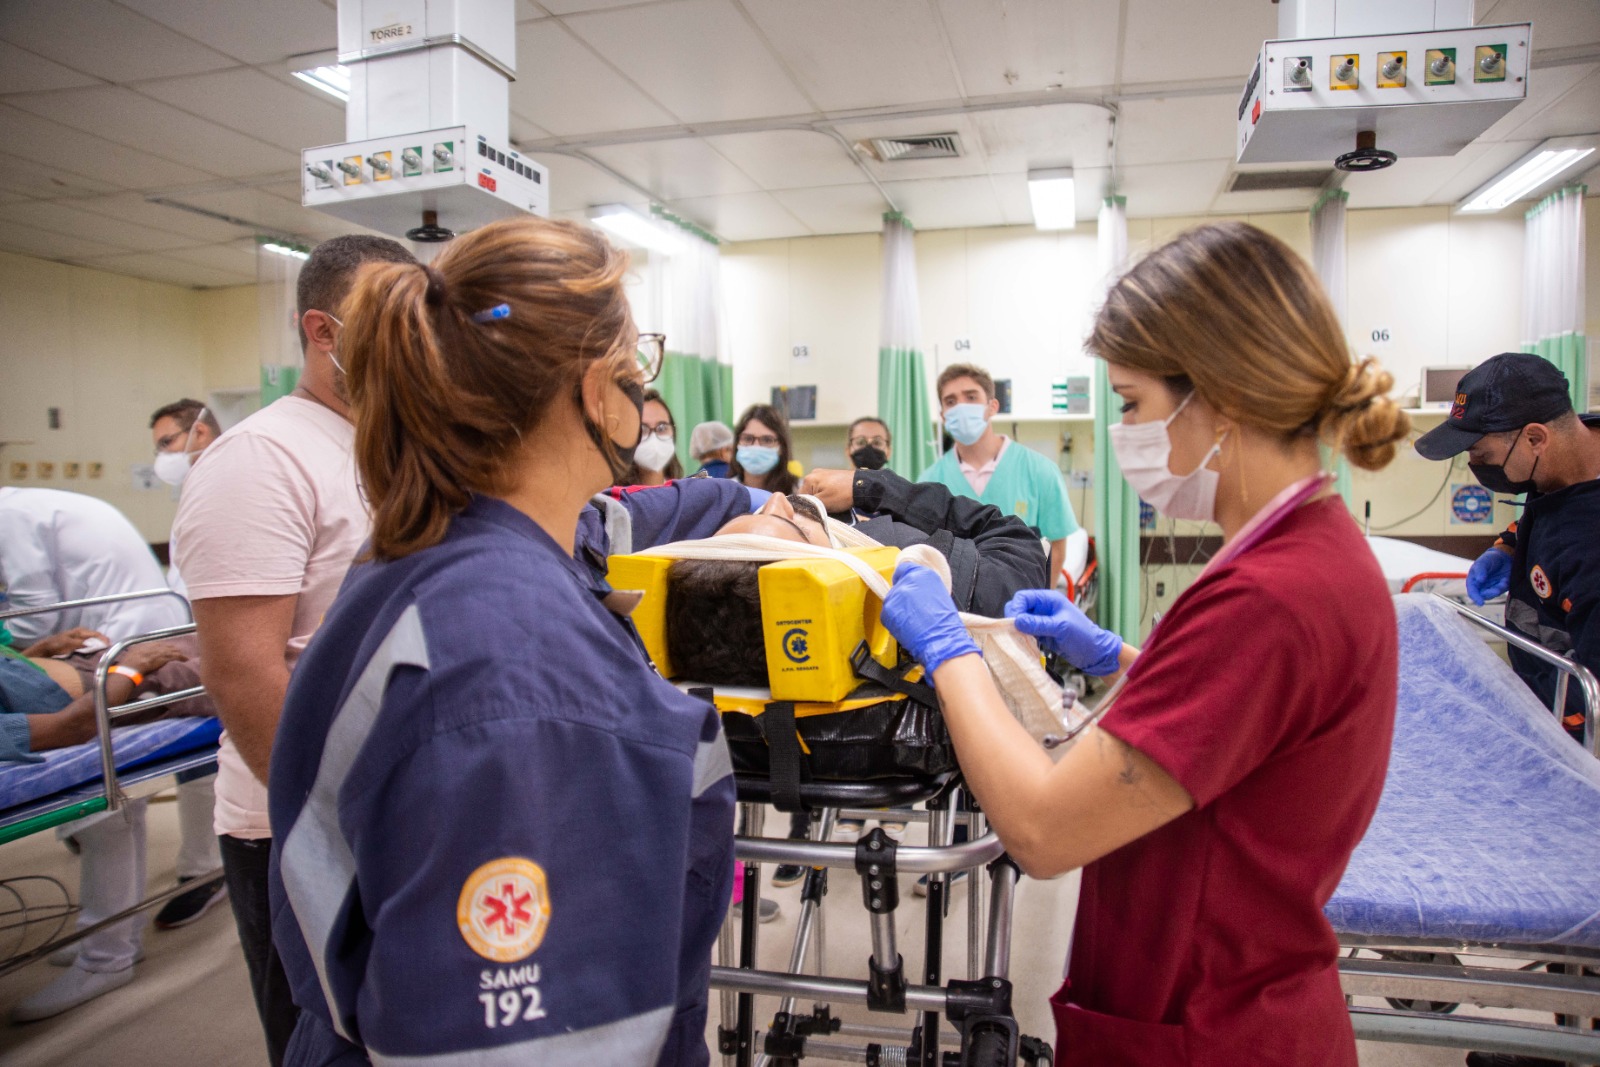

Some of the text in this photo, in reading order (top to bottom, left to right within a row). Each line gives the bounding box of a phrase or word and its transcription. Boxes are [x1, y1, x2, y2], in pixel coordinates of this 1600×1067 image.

[370, 25, 412, 40] TORRE 2
[1371, 329, 1390, 342] 06
[792, 345, 808, 357] 03
[955, 339, 971, 351] 04
[479, 963, 540, 990] SAMU
[478, 987, 547, 1029] 192
